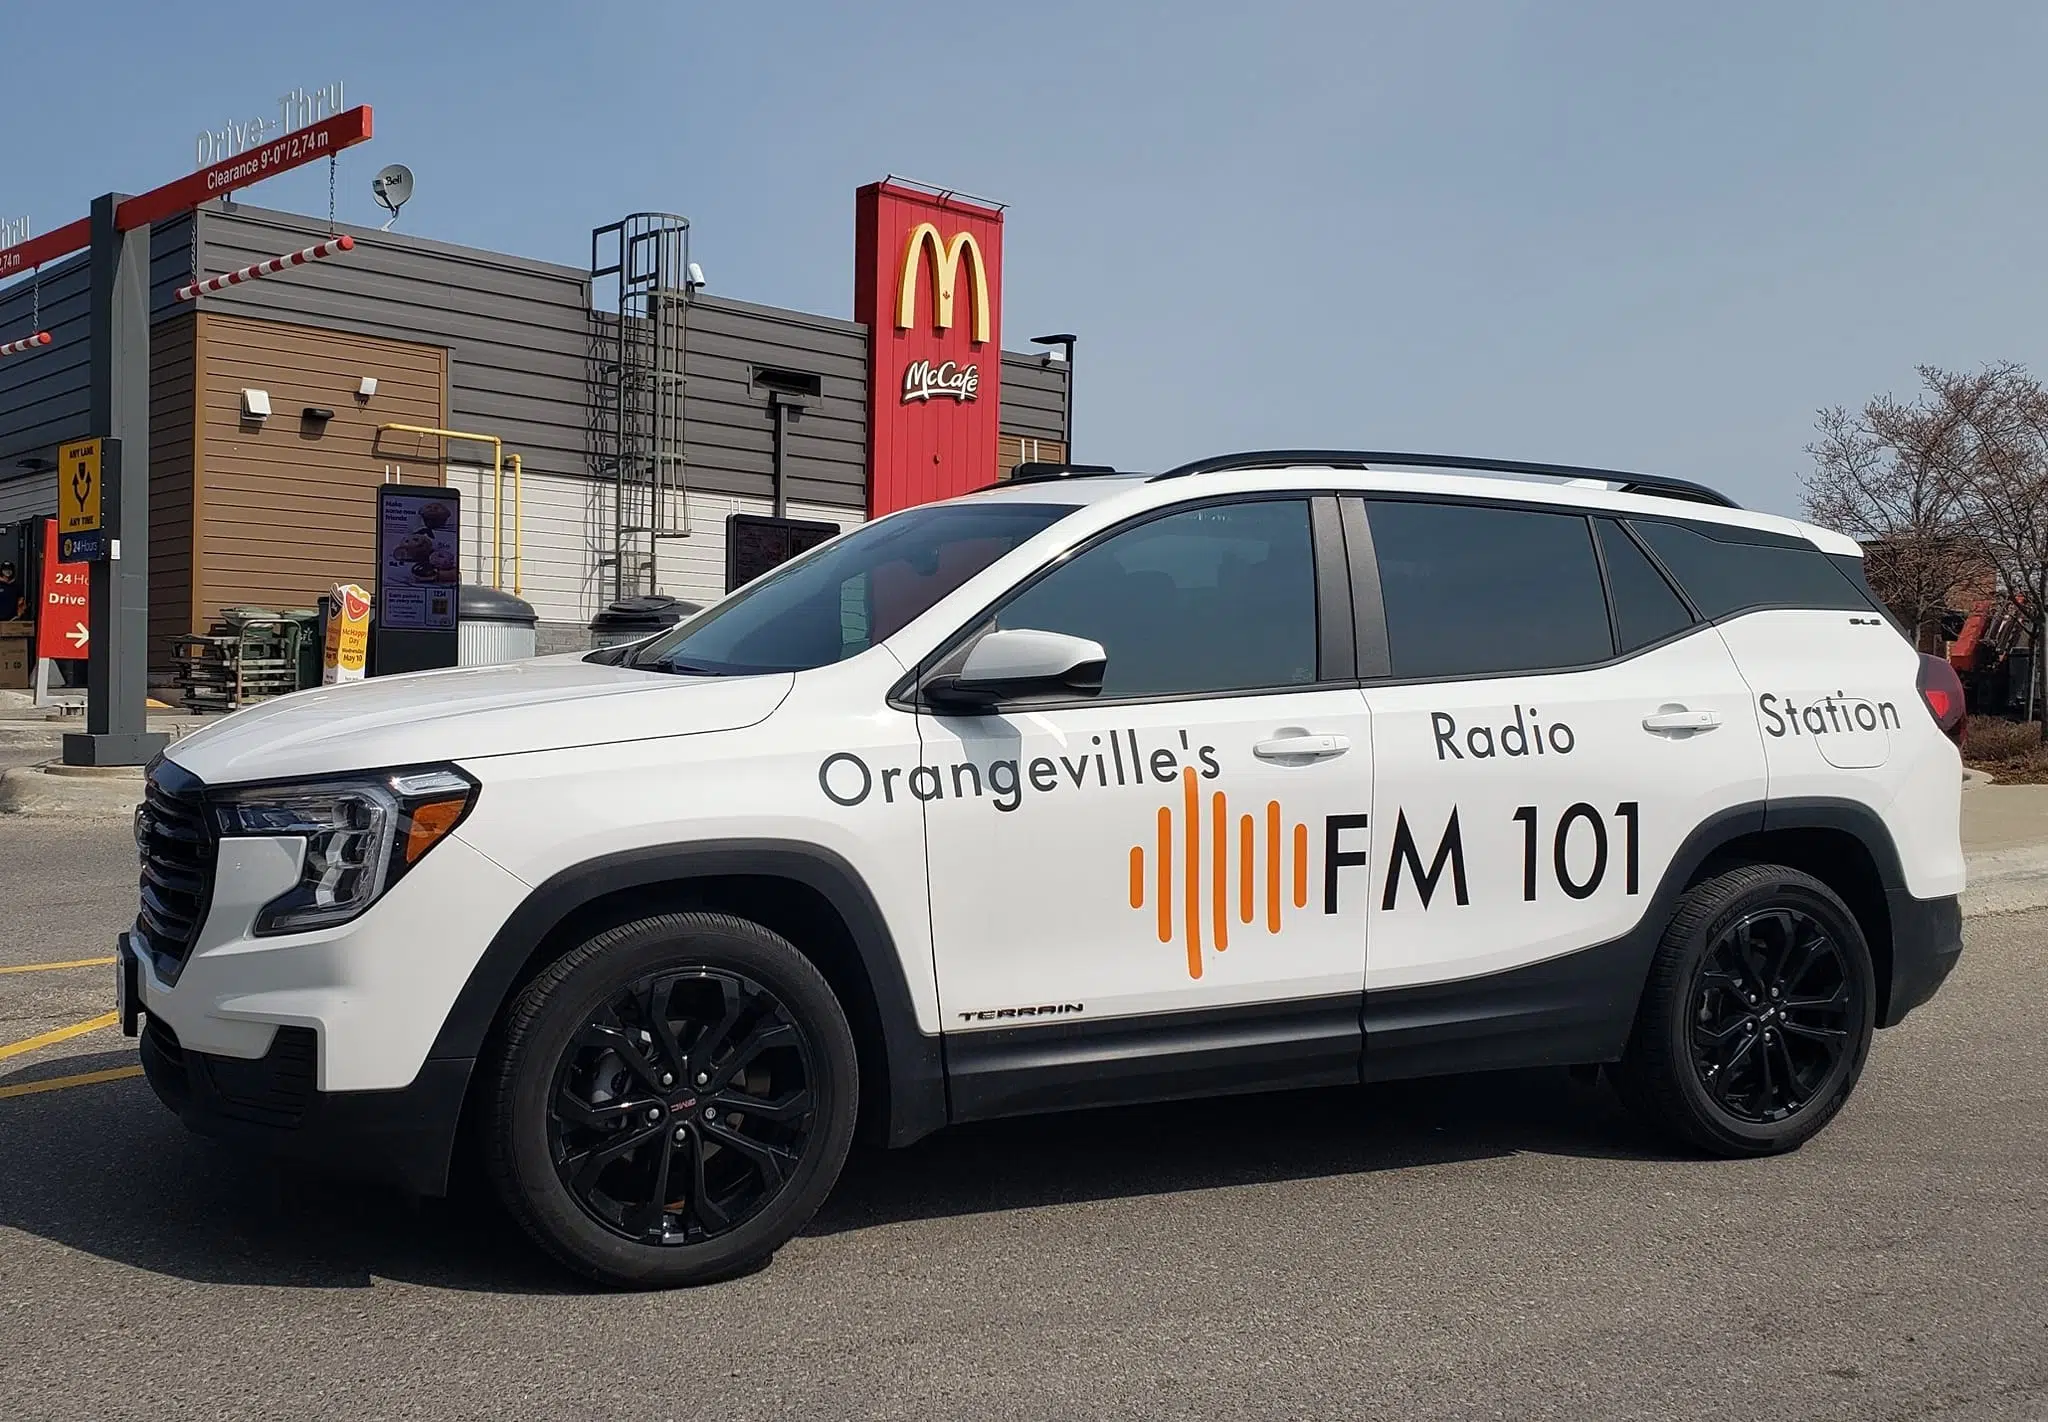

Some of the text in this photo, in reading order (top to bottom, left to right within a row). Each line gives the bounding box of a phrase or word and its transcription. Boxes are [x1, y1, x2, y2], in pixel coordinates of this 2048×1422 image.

[207, 159, 259, 190] Clearance
[385, 173, 402, 186] Bell
[904, 360, 979, 400] McCafé
[69, 446, 95, 460] ANY LANE
[69, 515, 95, 527] ANY TIME
[72, 539, 98, 553] 24 Hours
[55, 573, 72, 585] 24
[48, 593, 87, 606] Drive
[1849, 618, 1882, 626] SLE
[349, 637, 359, 646] Day
[343, 654, 363, 663] May 10
[818, 688, 1903, 812] Orangeville's Radio Station
[1323, 801, 1639, 915] FM 101
[957, 1002, 1084, 1021] TERRAIN
